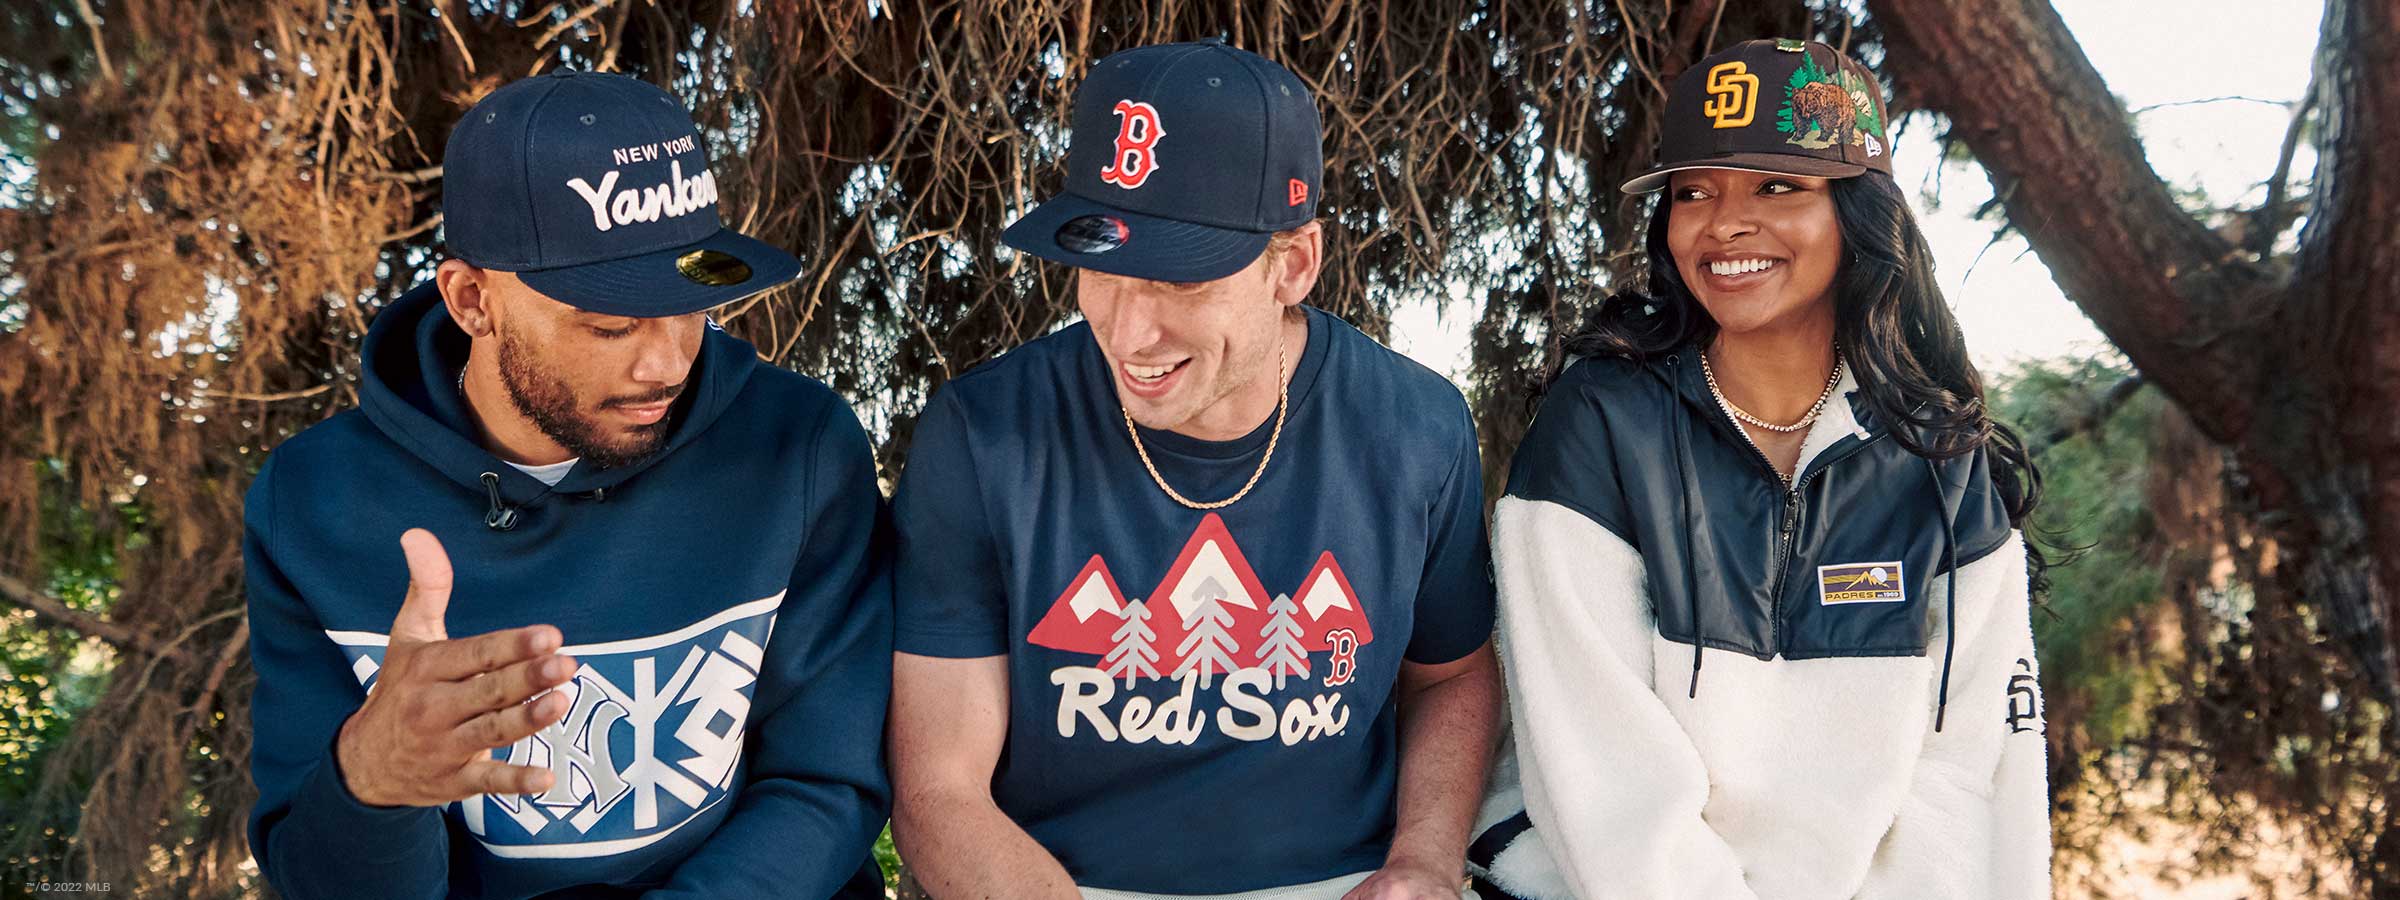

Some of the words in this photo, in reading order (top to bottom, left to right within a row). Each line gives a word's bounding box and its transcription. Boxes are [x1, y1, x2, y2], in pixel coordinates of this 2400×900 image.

[1704, 61, 1760, 129] SD
[613, 143, 659, 166] NEW
[662, 134, 696, 157] YORK
[1101, 99, 1168, 190] B
[1825, 592, 1874, 600] PADRES
[1324, 628, 1360, 688] B
[1050, 665, 1207, 746] Red
[1216, 666, 1350, 746] Sox
[488, 675, 631, 814] NY
